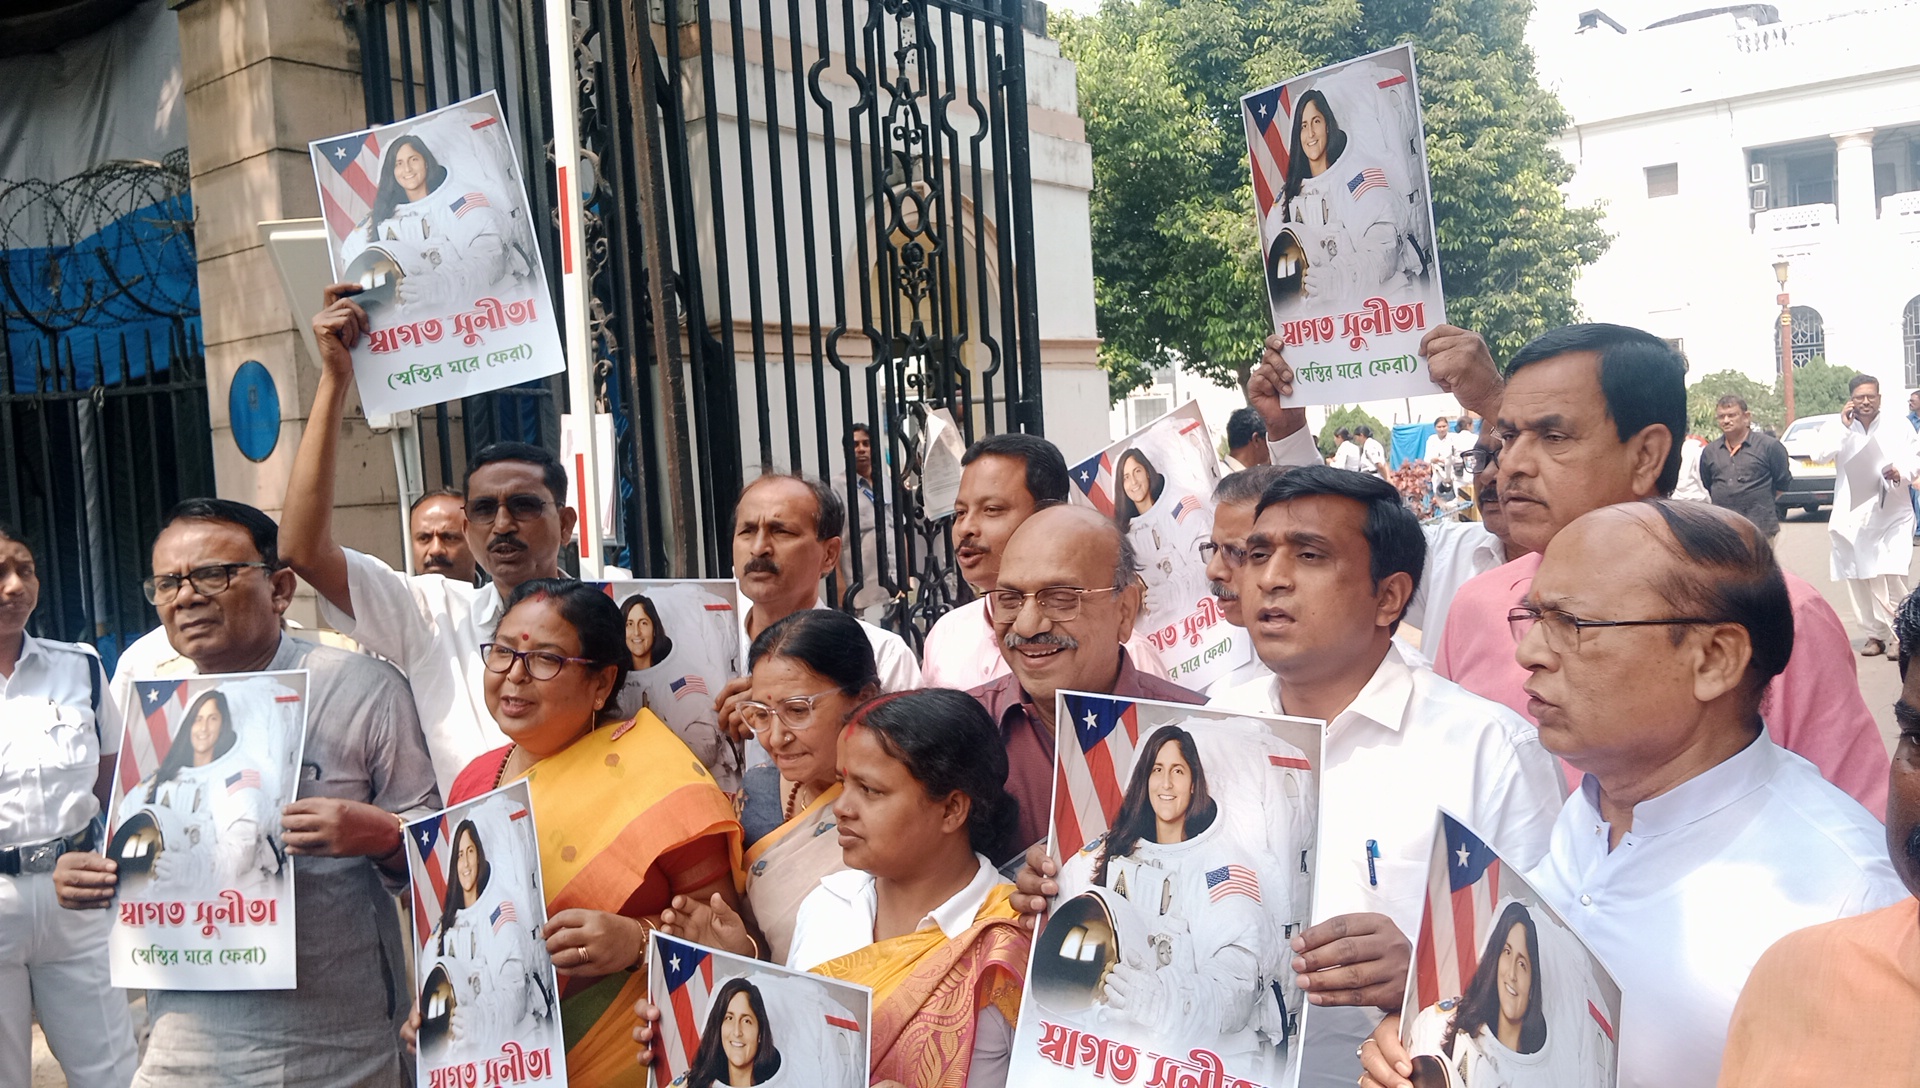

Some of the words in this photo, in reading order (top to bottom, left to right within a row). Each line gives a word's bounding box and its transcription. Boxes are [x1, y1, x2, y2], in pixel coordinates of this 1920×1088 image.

[367, 317, 444, 354] স্বাগত
[448, 296, 538, 346] সুনীতা
[1281, 316, 1335, 346] স্বাগত
[1337, 296, 1425, 350] সুনীতা
[387, 363, 443, 390] (স্বস্তির
[448, 356, 480, 375] ঘরে
[486, 343, 533, 368] ফেরা)
[1295, 361, 1333, 384] (স্বস্তির
[1336, 362, 1362, 379] ঘরে
[1369, 354, 1418, 377] ফেরা)
[1180, 655, 1200, 675] ঘরে
[1203, 636, 1232, 665] ফেরা)
[119, 900, 187, 928] স্বাগত
[192, 889, 279, 939] সুনীতা
[131, 944, 178, 965] (স্বস্তির
[184, 949, 213, 965] ঘরে
[219, 946, 267, 965] ফেরা)
[1037, 1020, 1141, 1084] স্বাগত
